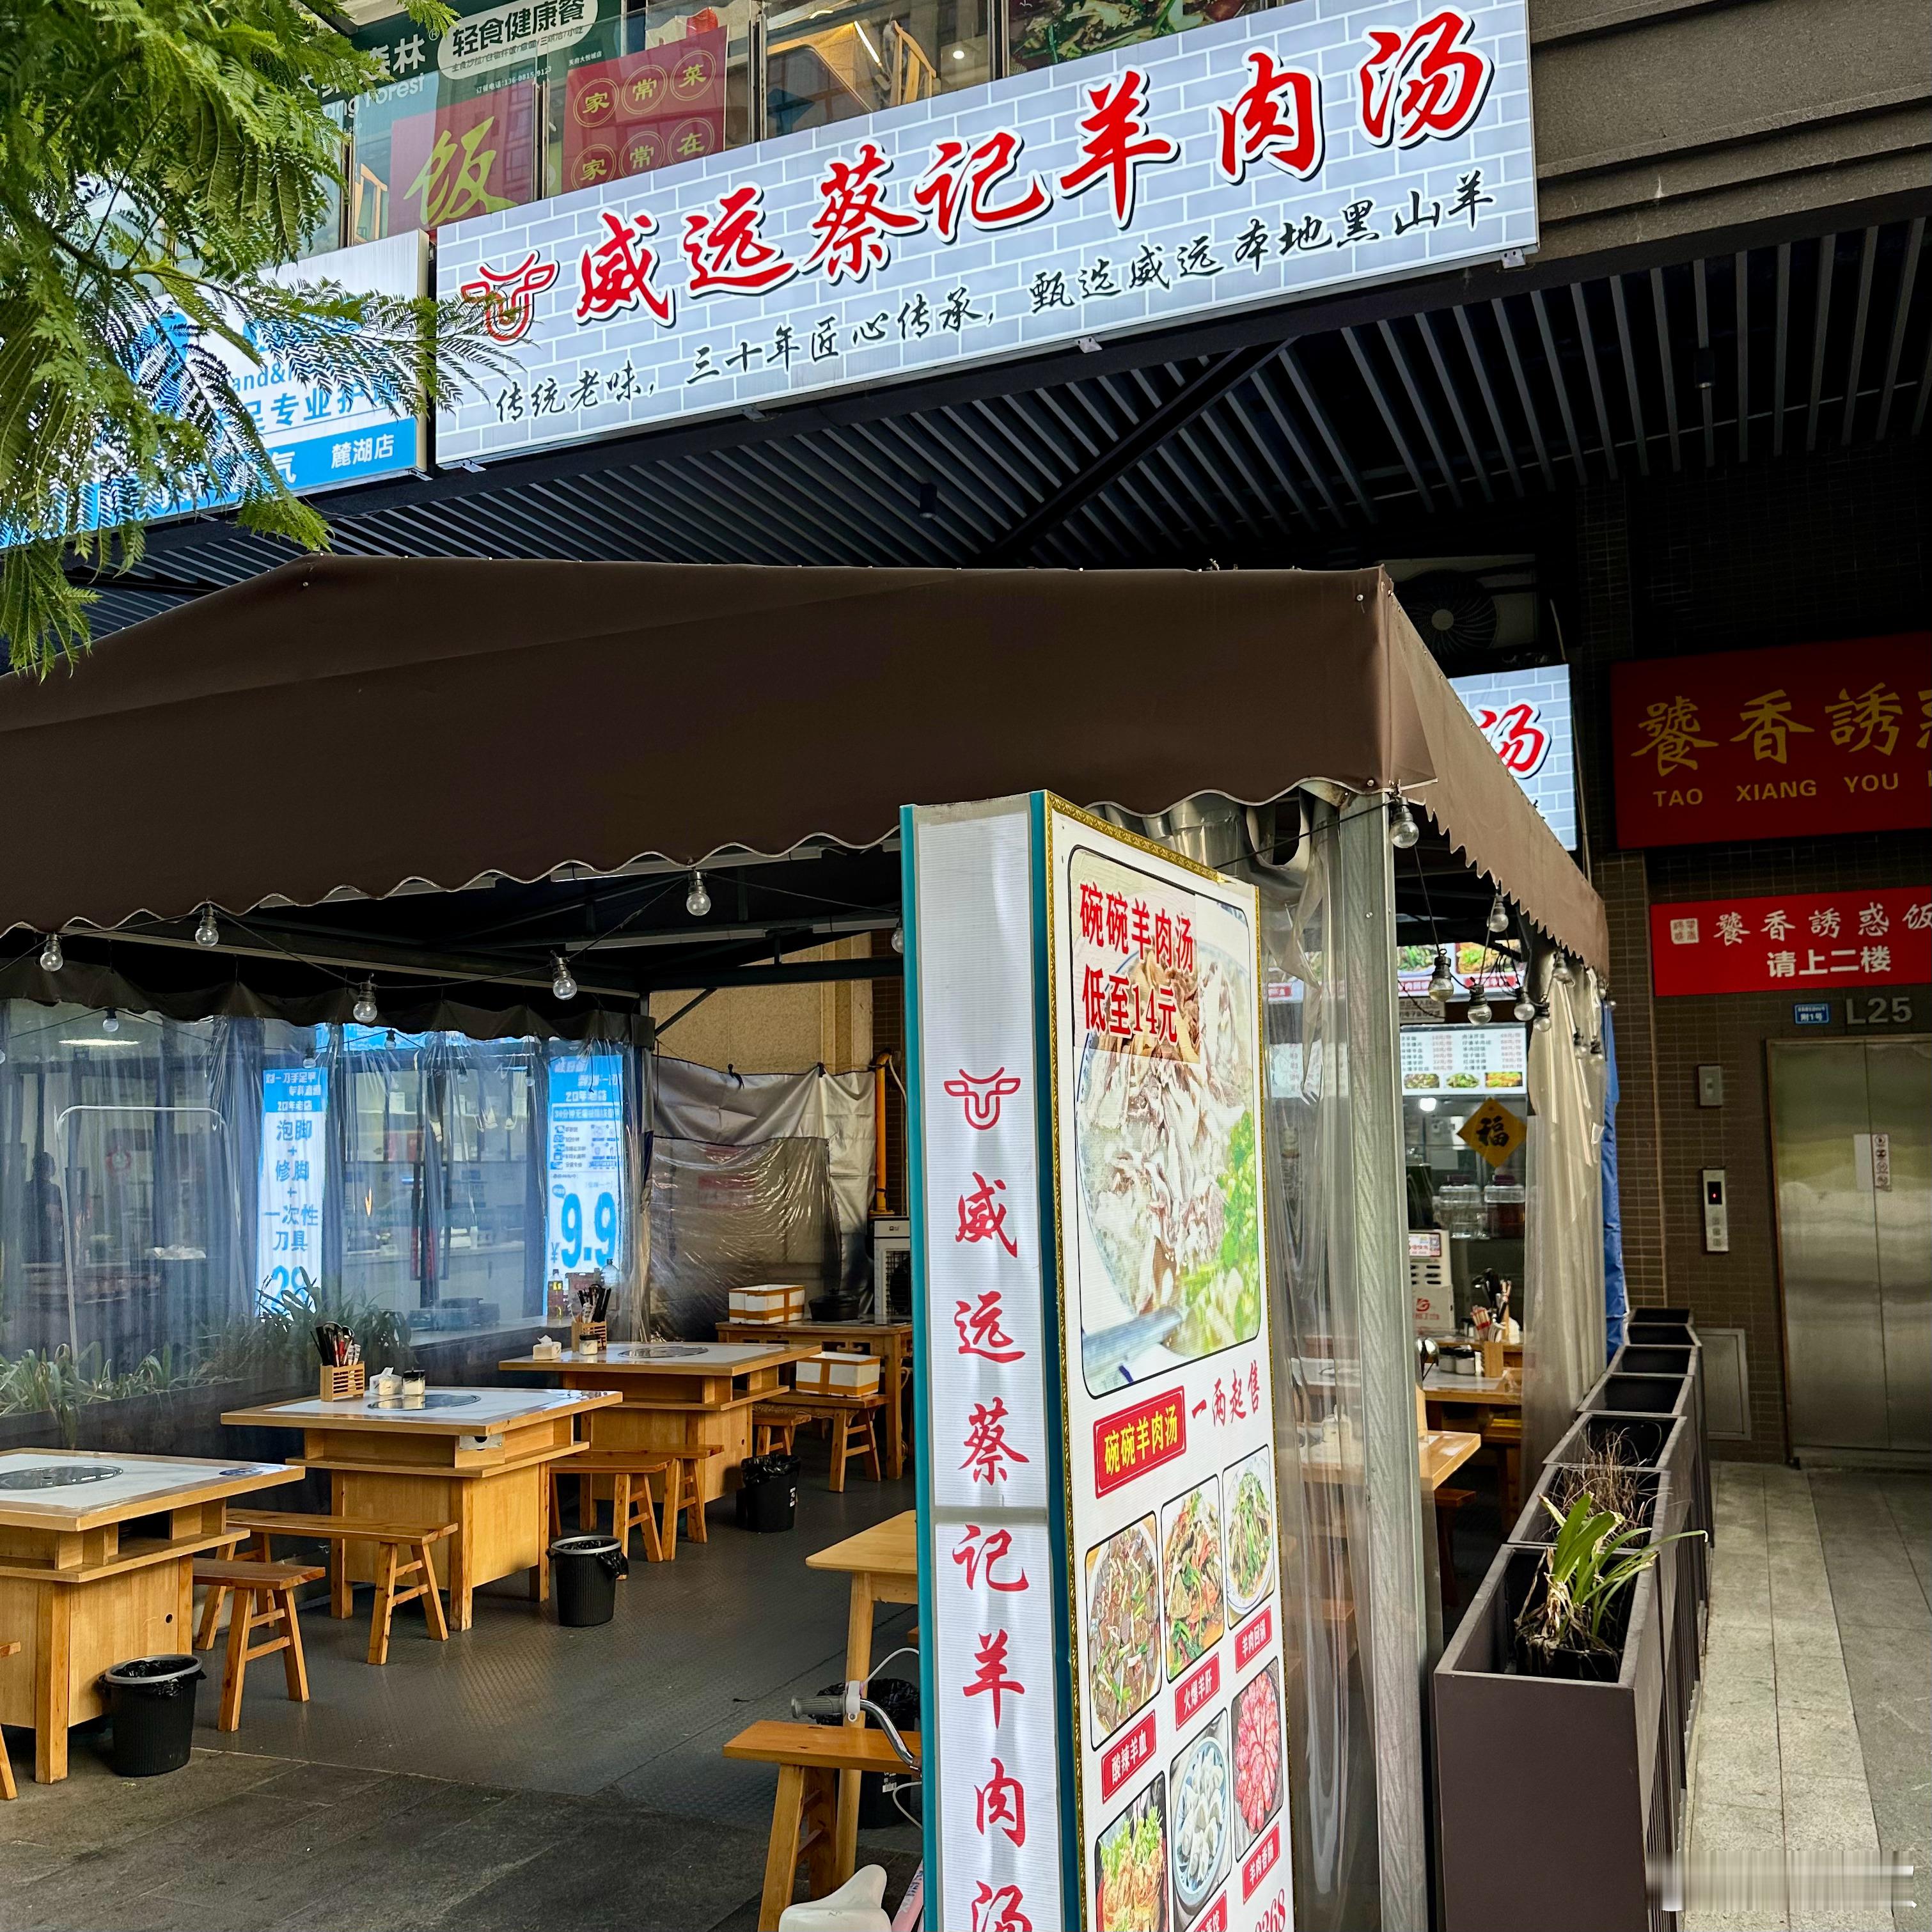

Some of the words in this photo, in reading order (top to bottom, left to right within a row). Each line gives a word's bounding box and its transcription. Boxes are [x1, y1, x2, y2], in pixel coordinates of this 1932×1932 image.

[453, 0, 585, 57] 轻食健康餐
[581, 62, 707, 114] 家常菜
[404, 116, 519, 228] 饭
[579, 132, 705, 181] 家常在
[579, 11, 1486, 321] 威远蔡记羊肉汤
[331, 434, 395, 469] 麓湖店
[1653, 789, 1703, 807] TAO
[1736, 779, 1817, 803] XIANG
[1843, 773, 1899, 795] YOU
[1080, 881, 1195, 974] 碗碗羊肉汤
[1767, 945, 1892, 978] 请上二楼
[1082, 964, 1178, 1044] 低至14元
[1846, 997, 1913, 1024] L25
[276, 1120, 312, 1141] 泡脚
[1476, 1115, 1509, 1147] 福
[276, 1159, 310, 1182] 修脚
[265, 1204, 318, 1226] 一次性
[272, 1230, 308, 1252] 刀具
[1191, 1359, 1261, 1427] 一两起售
[1104, 1403, 1179, 1476] 碗碗羊肉汤
[1241, 1619, 1267, 1658] 羊肉回锅
[1183, 1667, 1213, 1716] 火爆羊肝
[1111, 1729, 1147, 1786] 酸辣羊血
